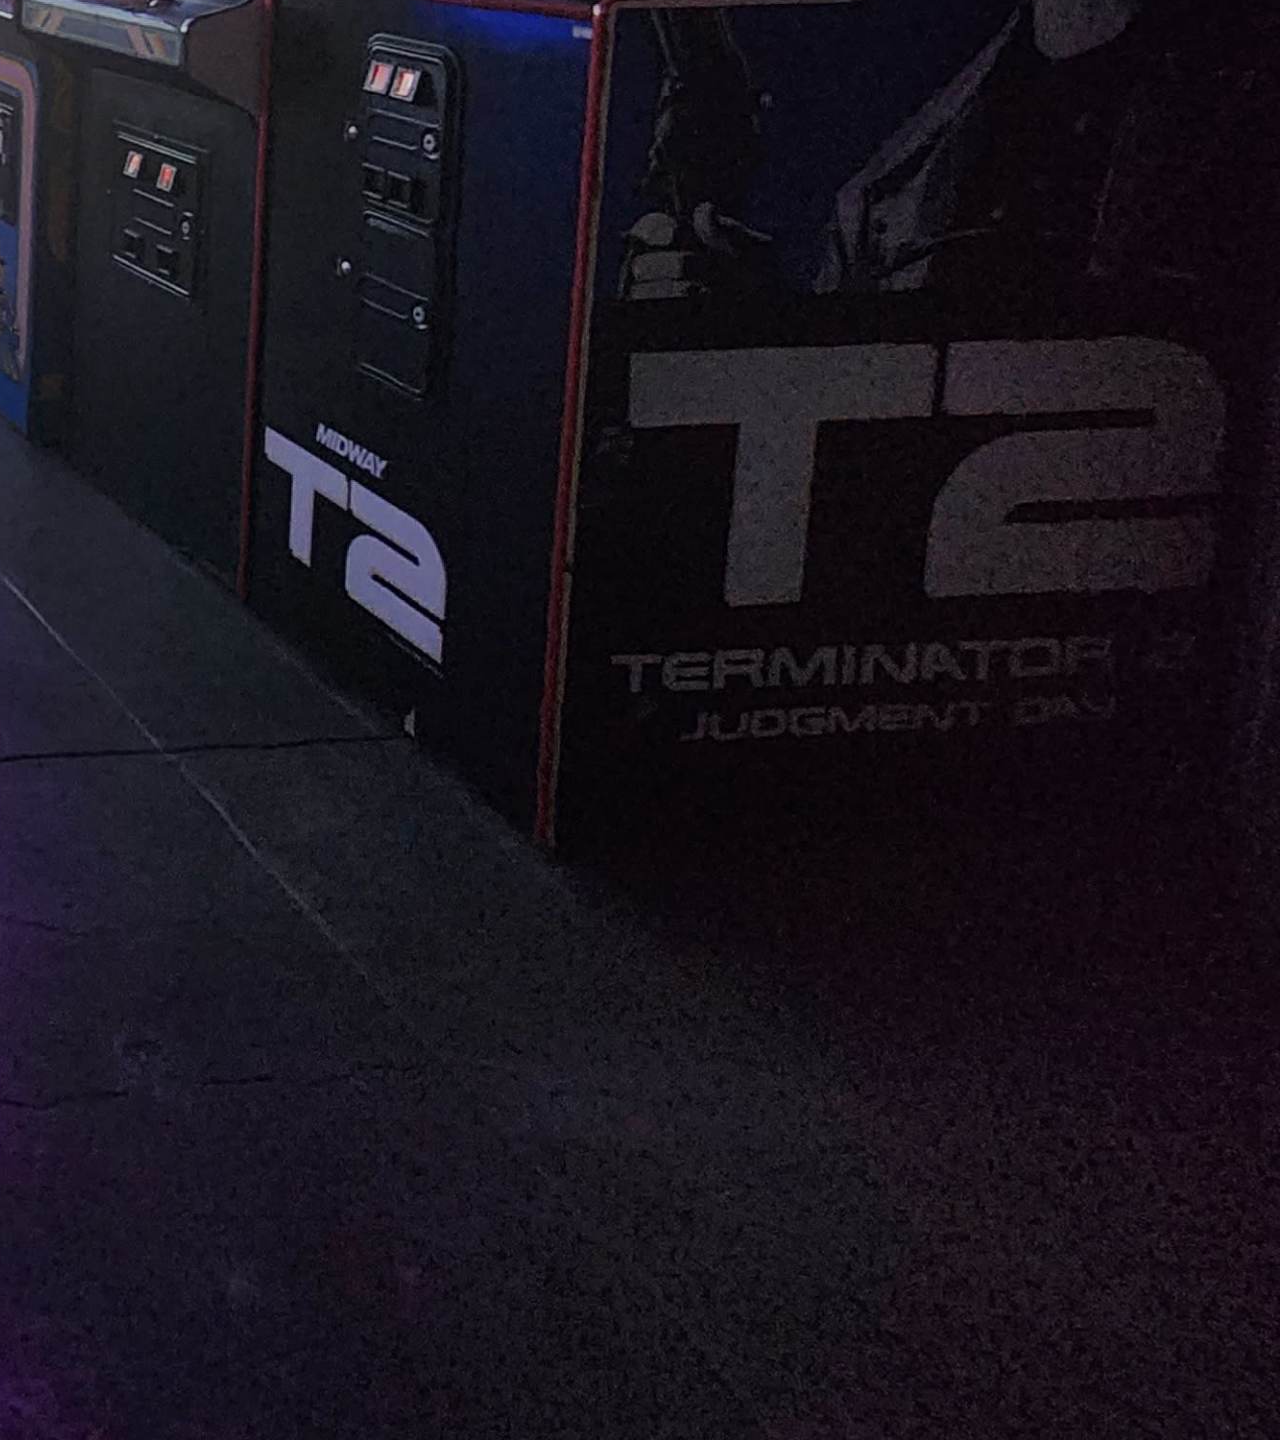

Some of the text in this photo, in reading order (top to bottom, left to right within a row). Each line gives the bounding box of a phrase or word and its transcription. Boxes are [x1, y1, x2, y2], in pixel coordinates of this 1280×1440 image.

[316, 423, 388, 481] MIDWAY
[630, 334, 1228, 607] T2
[264, 426, 447, 664] T2
[610, 635, 1113, 693] TERMINATOR
[679, 697, 989, 743] JUDGMENT
